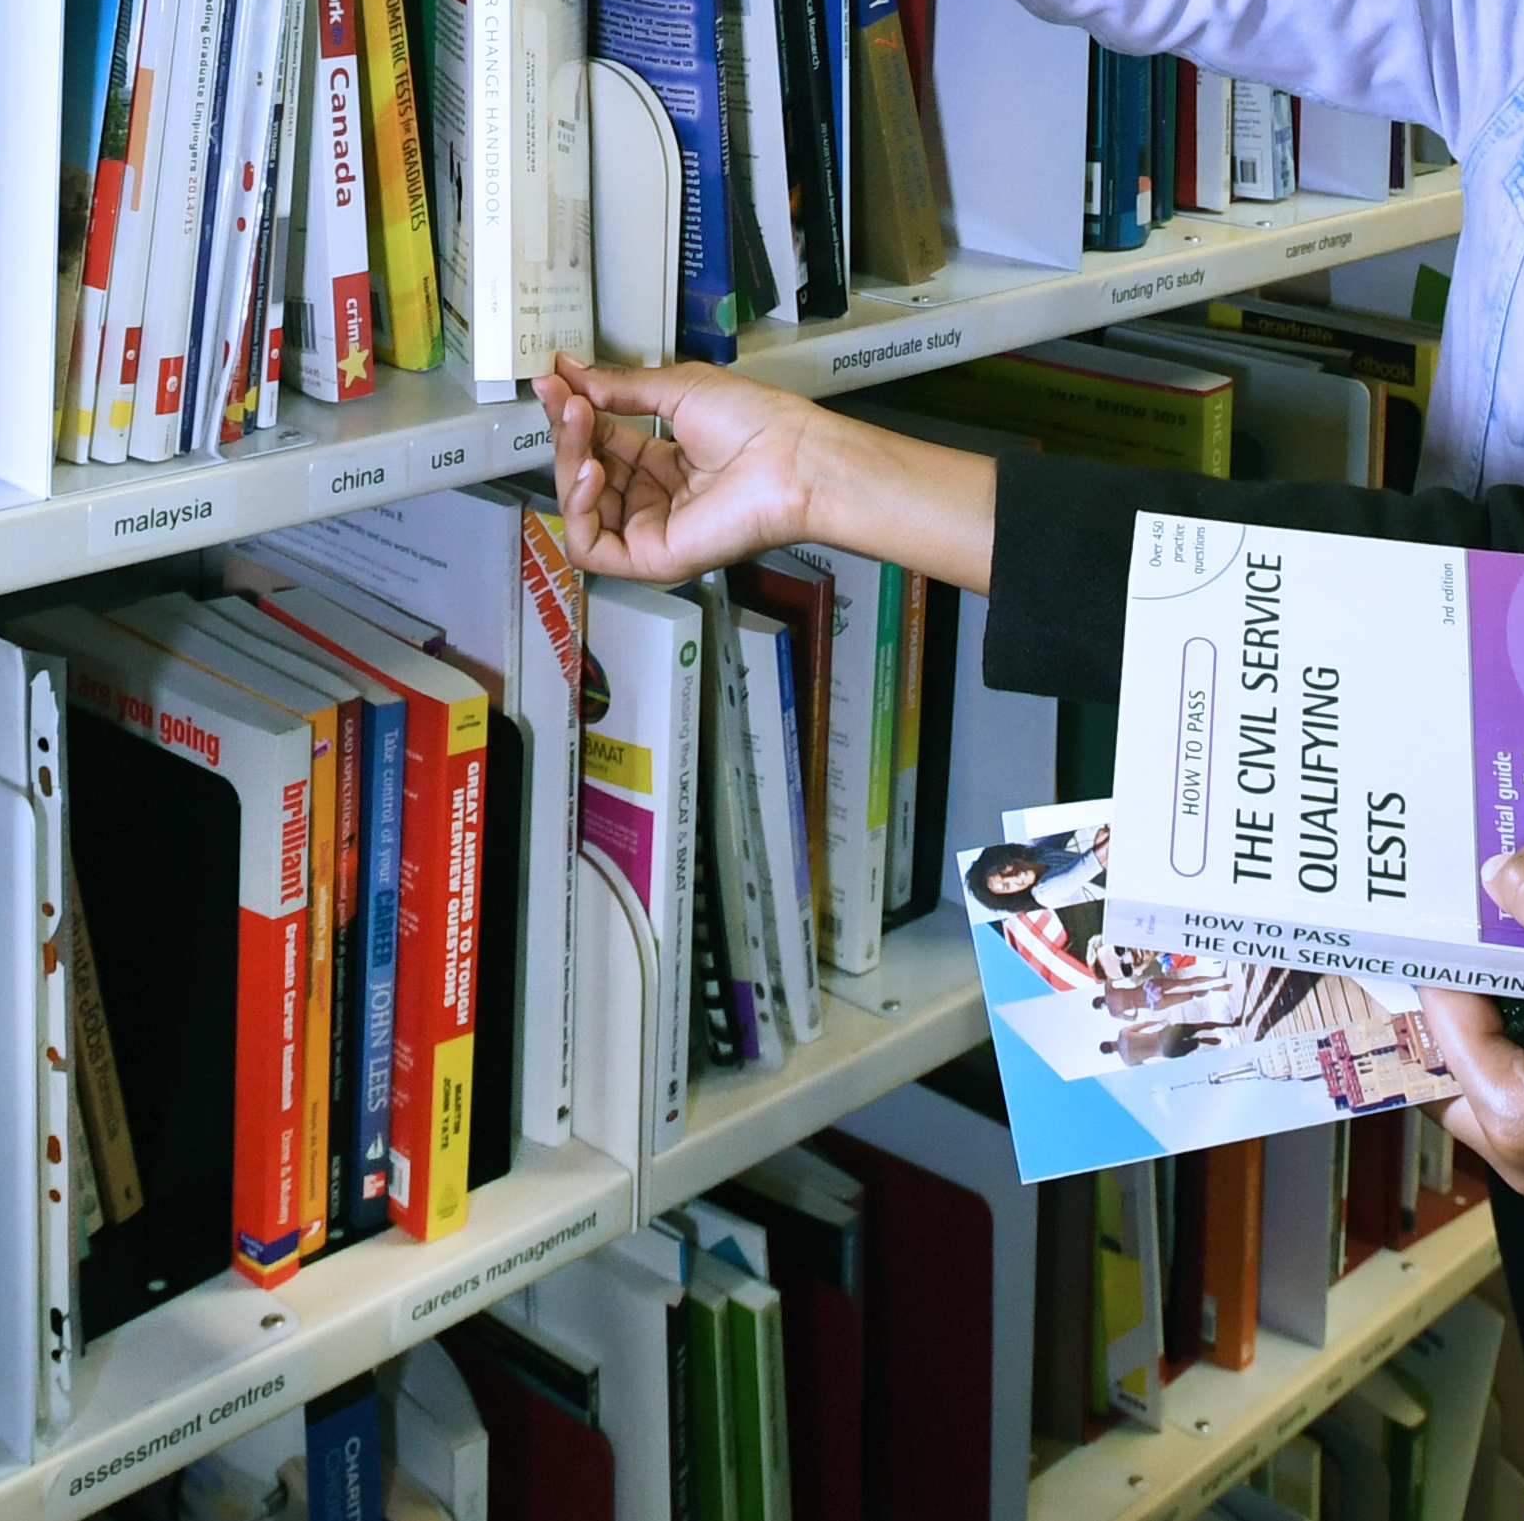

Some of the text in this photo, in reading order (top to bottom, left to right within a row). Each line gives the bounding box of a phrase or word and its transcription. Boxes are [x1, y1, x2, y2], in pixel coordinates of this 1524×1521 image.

[196, 36, 212, 98] Graduate
[485, 15, 499, 98] CHANGE
[809, 17, 820, 71] Research
[394, 65, 414, 118] TESTS
[190, 101, 205, 173] Employers
[329, 67, 356, 208] Canada
[400, 117, 411, 134] for
[402, 137, 426, 232] GRADUATES
[485, 107, 500, 227] HANDBOOK
[184, 177, 197, 235] 2014/15
[1285, 230, 1354, 259] career change
[1111, 268, 1205, 304] funding PG study
[833, 328, 962, 376] postgraduate study
[331, 466, 385, 494] china
[431, 447, 465, 471] usa
[114, 499, 213, 537] malaysia
[1149, 520, 1165, 567] Over 450
[1173, 524, 1186, 563] practice
[1195, 526, 1206, 575] questions
[1441, 563, 1455, 625] 3rd edition
[1233, 552, 1282, 884] THE CIVIL SERVICE
[1182, 690, 1205, 816] HOW TO PASS
[1298, 666, 1340, 893] QUALIFYING
[1367, 791, 1406, 902] TESTS
[443, 787, 465, 1008] INTERVIEW QUESTIONS
[456, 761, 480, 1026] GREAT ANSWERS TO TOUGH
[1182, 933, 1225, 953] THE
[1232, 940, 1291, 962] CIVIL
[1297, 949, 1395, 975] SERVICE
[1184, 913, 1351, 948] HOW TO PASS
[410, 1210, 598, 1322] careers management
[68, 1373, 285, 1498] assessment centres
